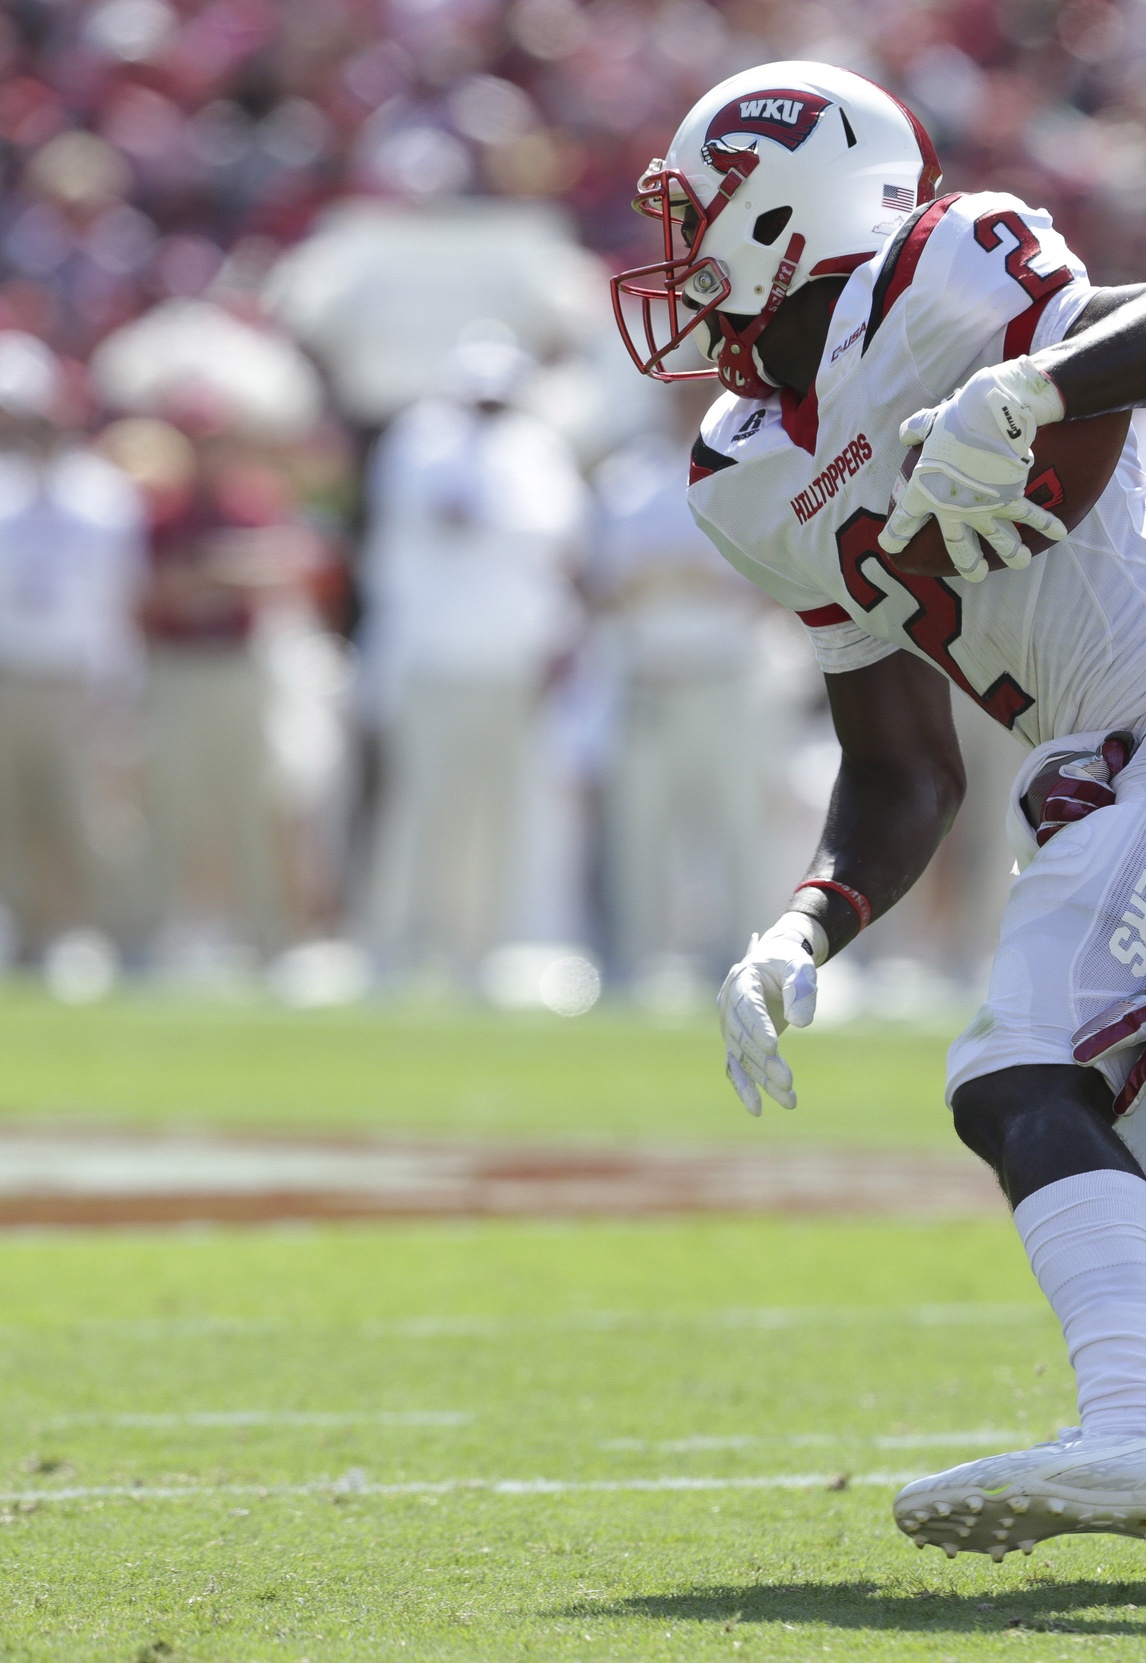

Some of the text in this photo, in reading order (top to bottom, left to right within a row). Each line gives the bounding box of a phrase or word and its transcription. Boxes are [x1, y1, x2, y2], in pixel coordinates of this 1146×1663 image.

[739, 98, 805, 125] WKU
[974, 208, 1075, 304] 2
[789, 433, 873, 526] HILLTOPPERS
[835, 505, 1036, 731] 2
